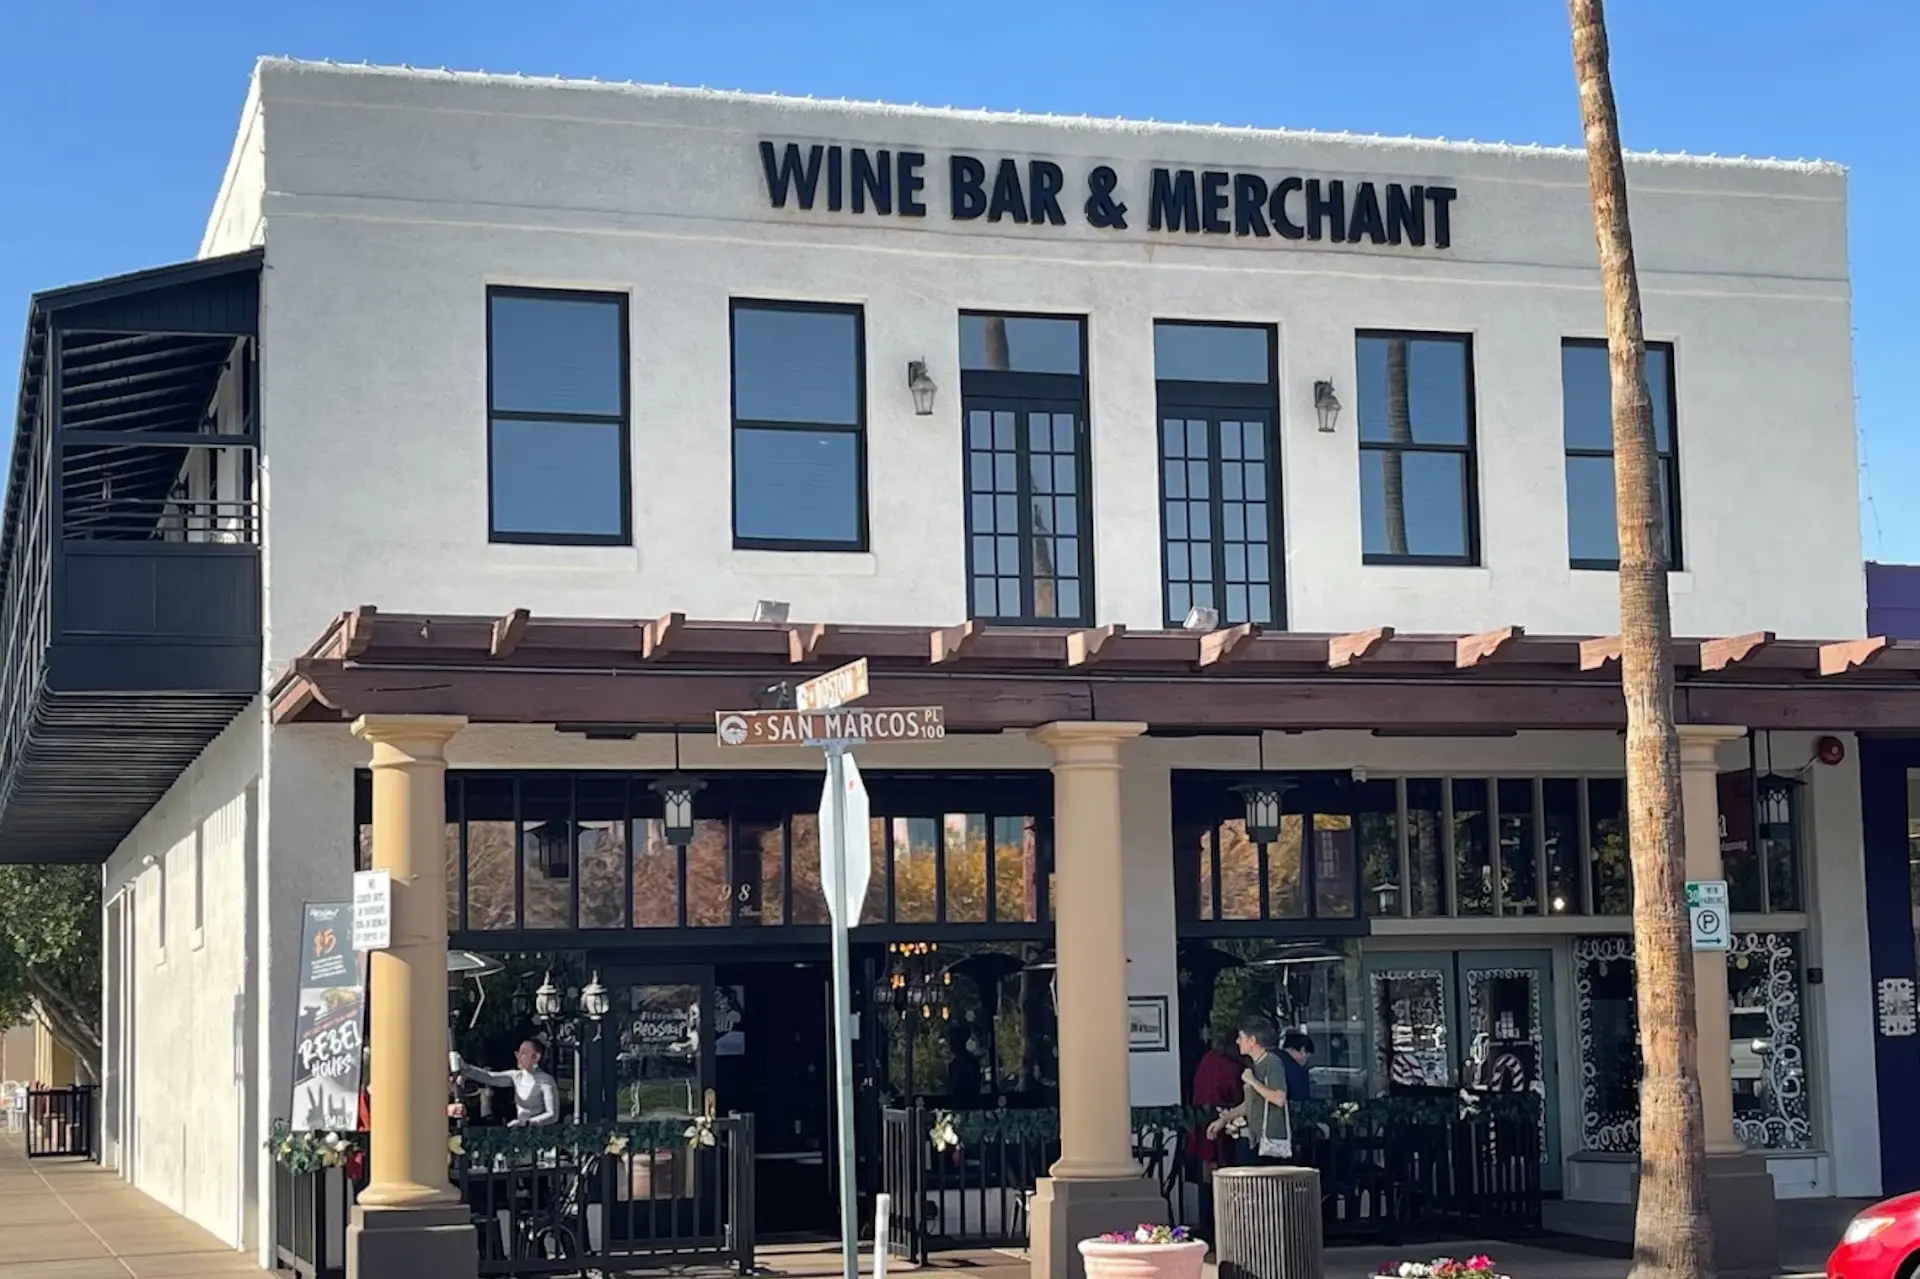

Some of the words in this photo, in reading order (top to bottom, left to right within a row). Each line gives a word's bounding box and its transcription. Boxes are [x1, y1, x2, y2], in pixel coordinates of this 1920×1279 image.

[758, 140, 926, 218] WINE
[949, 155, 1067, 226] BAR
[1083, 165, 1128, 230] &
[1147, 167, 1458, 250] MERCHANT
[754, 722, 763, 736] S
[767, 716, 812, 741] SAN
[825, 712, 919, 739] MARCOS
[924, 709, 939, 723] PL
[921, 725, 945, 739] 100
[1687, 889, 1698, 903] 30
[298, 1020, 362, 1070] REBEL
[311, 1053, 352, 1077] HOURS
